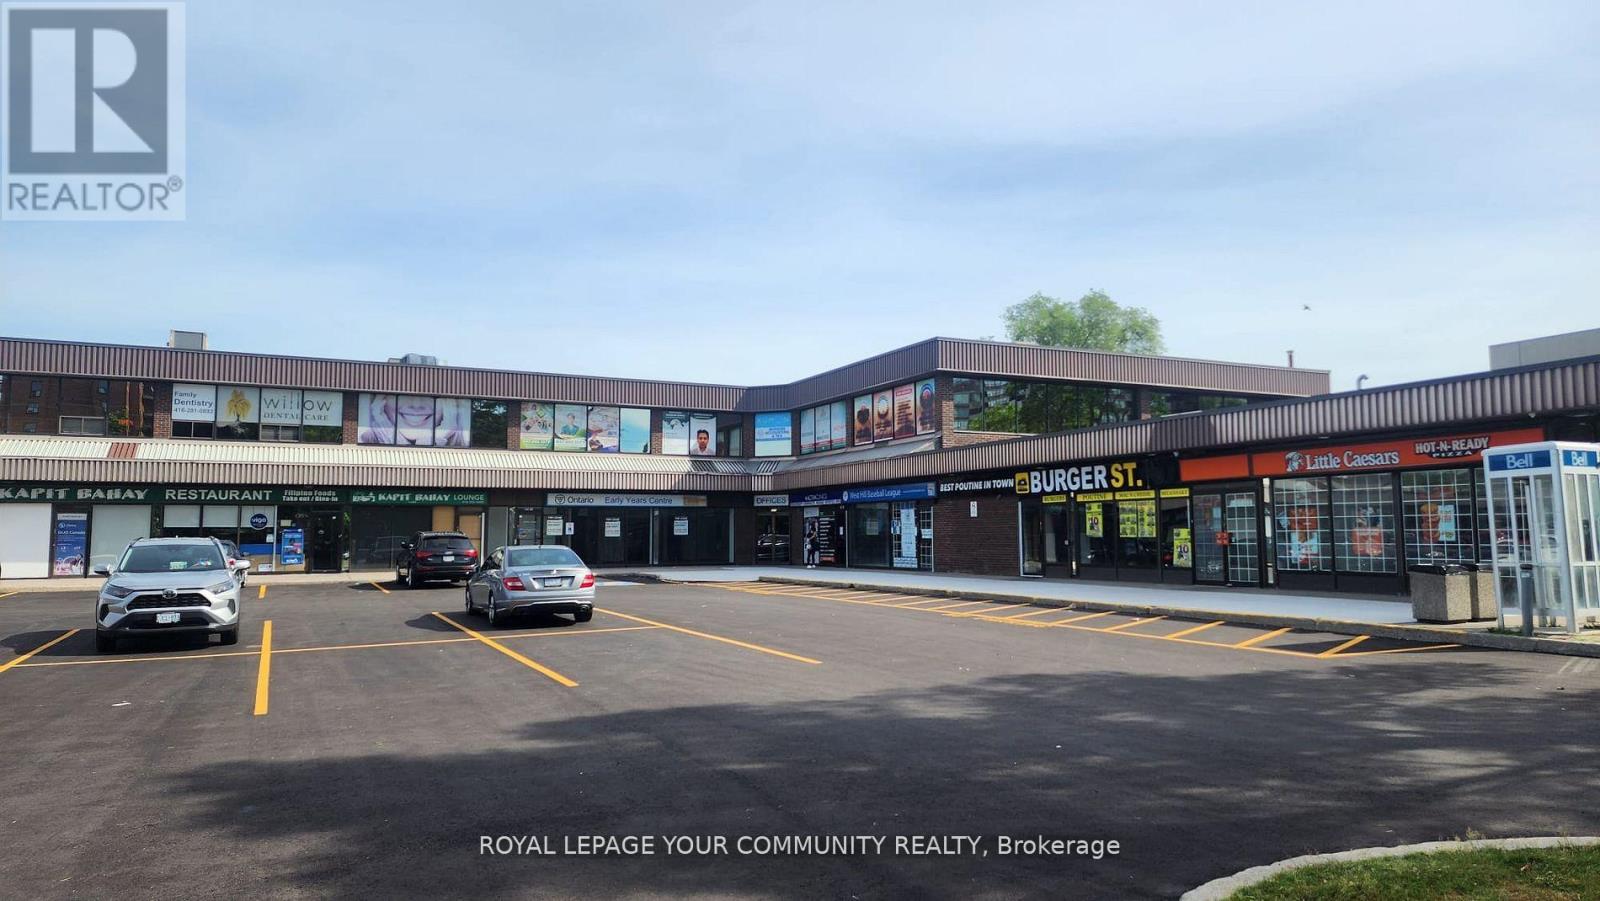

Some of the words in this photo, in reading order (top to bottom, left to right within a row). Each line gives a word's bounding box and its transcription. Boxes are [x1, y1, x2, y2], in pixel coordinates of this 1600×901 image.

[174, 399, 214, 408] Dentistry
[1415, 437, 1489, 454] HOT-N-READY
[1305, 451, 1340, 470] Little
[1343, 450, 1400, 467] Caesars
[1432, 450, 1472, 458] PIZZA
[1571, 452, 1588, 466] Bell
[1506, 453, 1533, 469] Bell
[1030, 465, 1108, 493] BURGER
[1111, 462, 1143, 488] ST.
[939, 483, 955, 492] BEST
[955, 481, 983, 491] POUTINE
[984, 480, 991, 489] IN
[992, 478, 1014, 488] TOWN
[0, 488, 70, 500] KAPIT
[77, 488, 149, 500] BAHAY
[165, 489, 273, 501] RESTAURANT
[378, 493, 410, 501] KAPIT
[415, 493, 450, 501] BAHAY
[885, 488, 901, 498] League
[567, 496, 594, 504] Ontario
[604, 496, 624, 505] Early
[626, 496, 647, 504] Years
[649, 496, 673, 505] Centre
[756, 496, 786, 505] OFFICES
